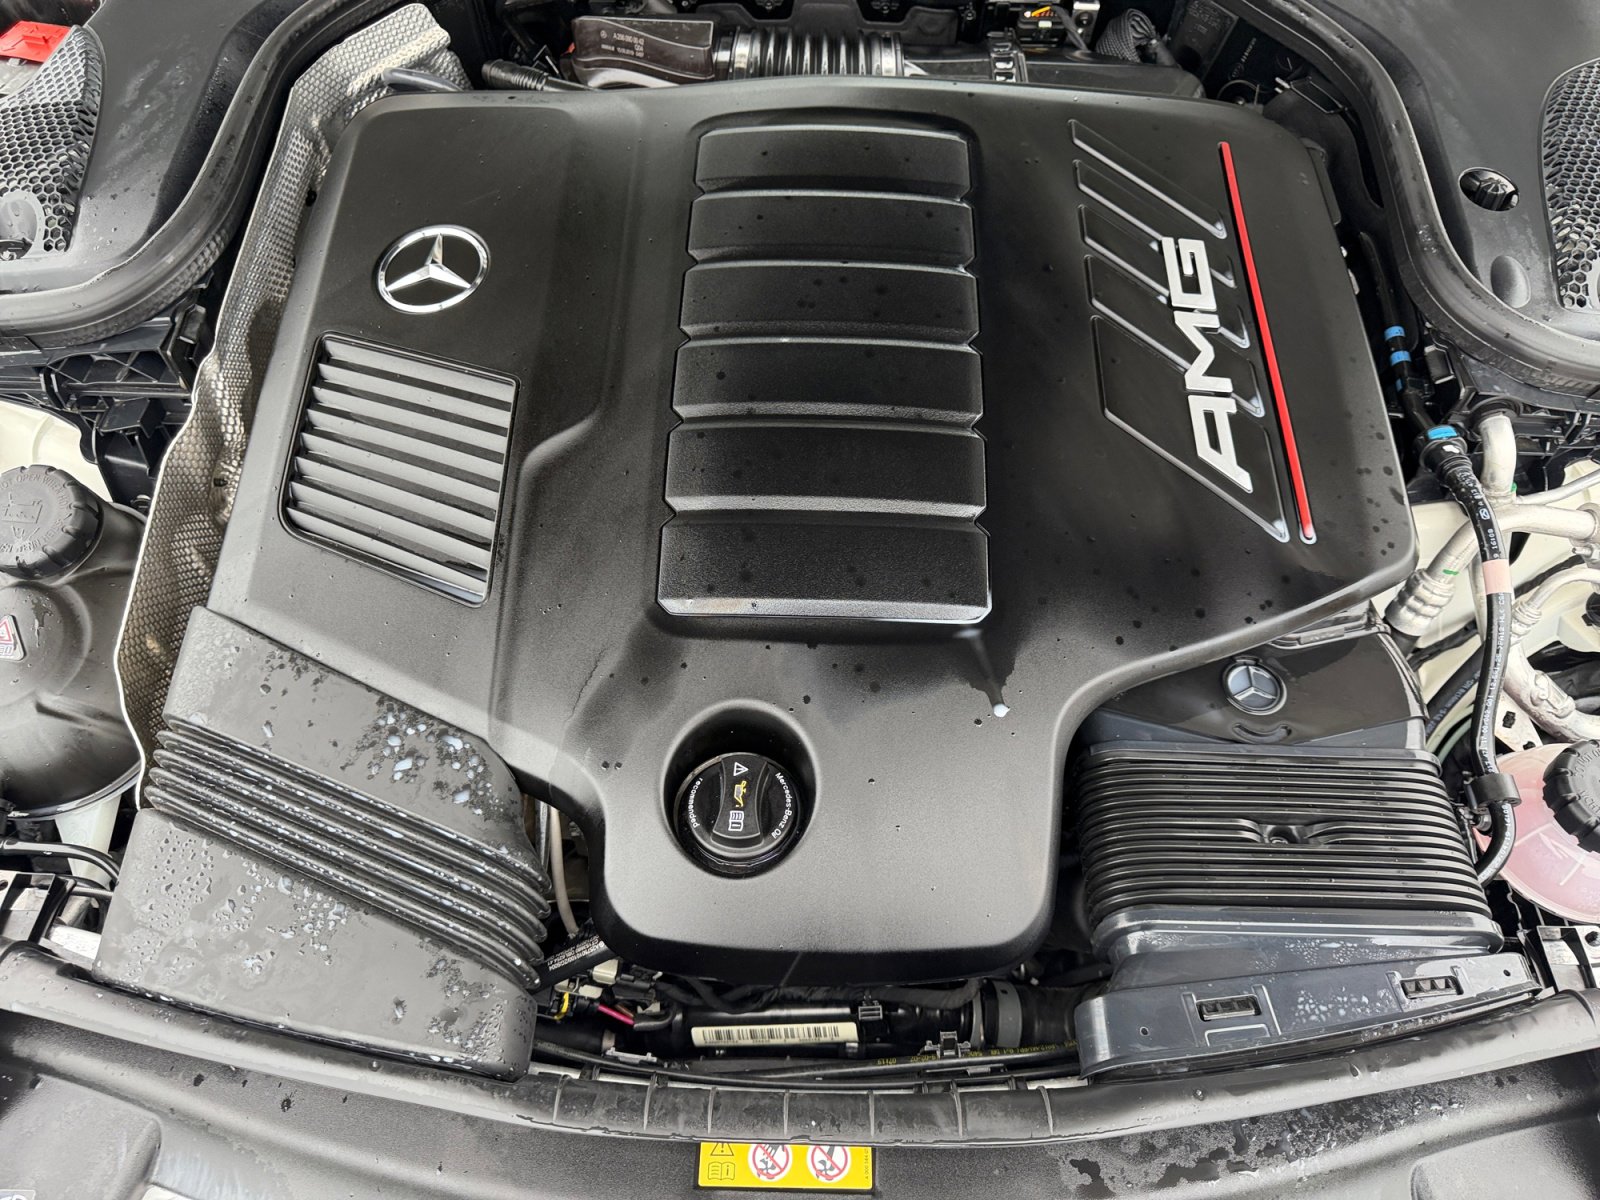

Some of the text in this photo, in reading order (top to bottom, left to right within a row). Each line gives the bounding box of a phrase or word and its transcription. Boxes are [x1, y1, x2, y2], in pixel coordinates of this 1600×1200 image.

[1161, 236, 1254, 494] AMG
[687, 777, 704, 829] recommended
[774, 772, 793, 829] Mercedes-Benz
